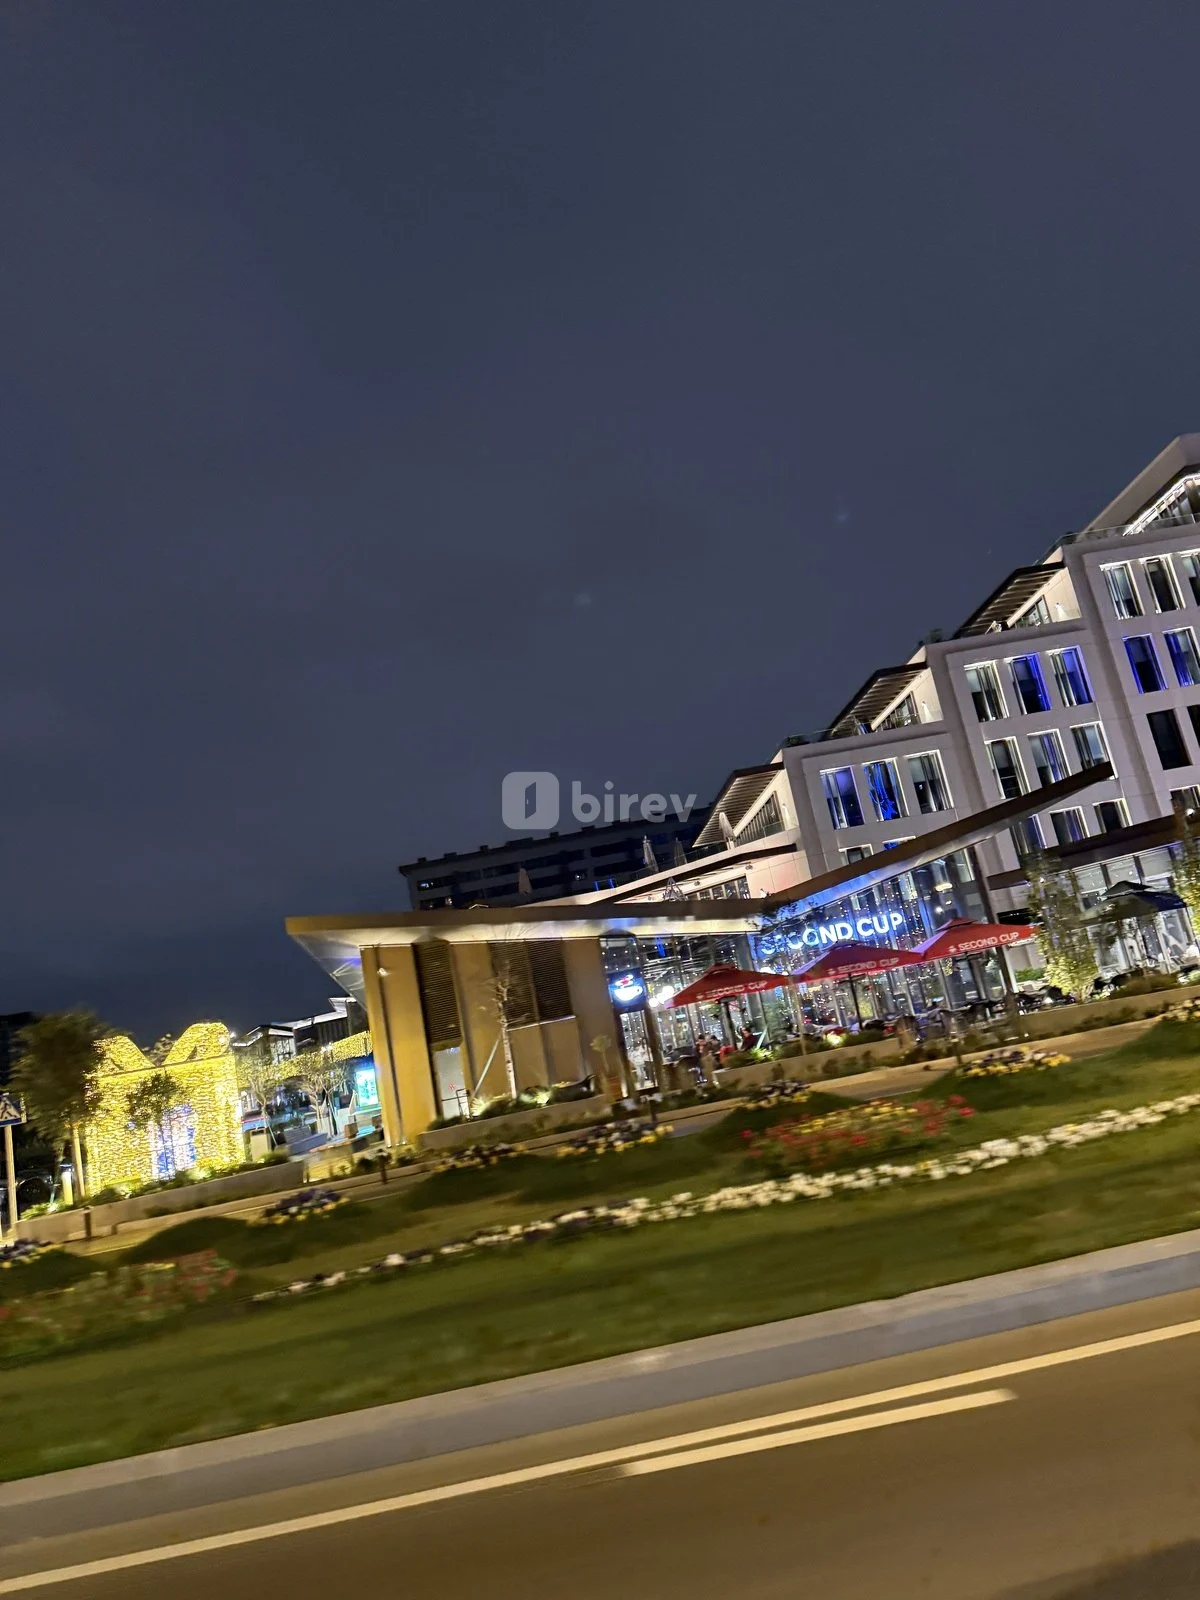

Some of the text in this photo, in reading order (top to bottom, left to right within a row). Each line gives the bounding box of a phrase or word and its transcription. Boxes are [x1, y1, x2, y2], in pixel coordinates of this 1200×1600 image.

[857, 912, 903, 937] CUP
[958, 932, 1019, 951] SECOND CUP
[837, 957, 899, 973] SECOND CUP
